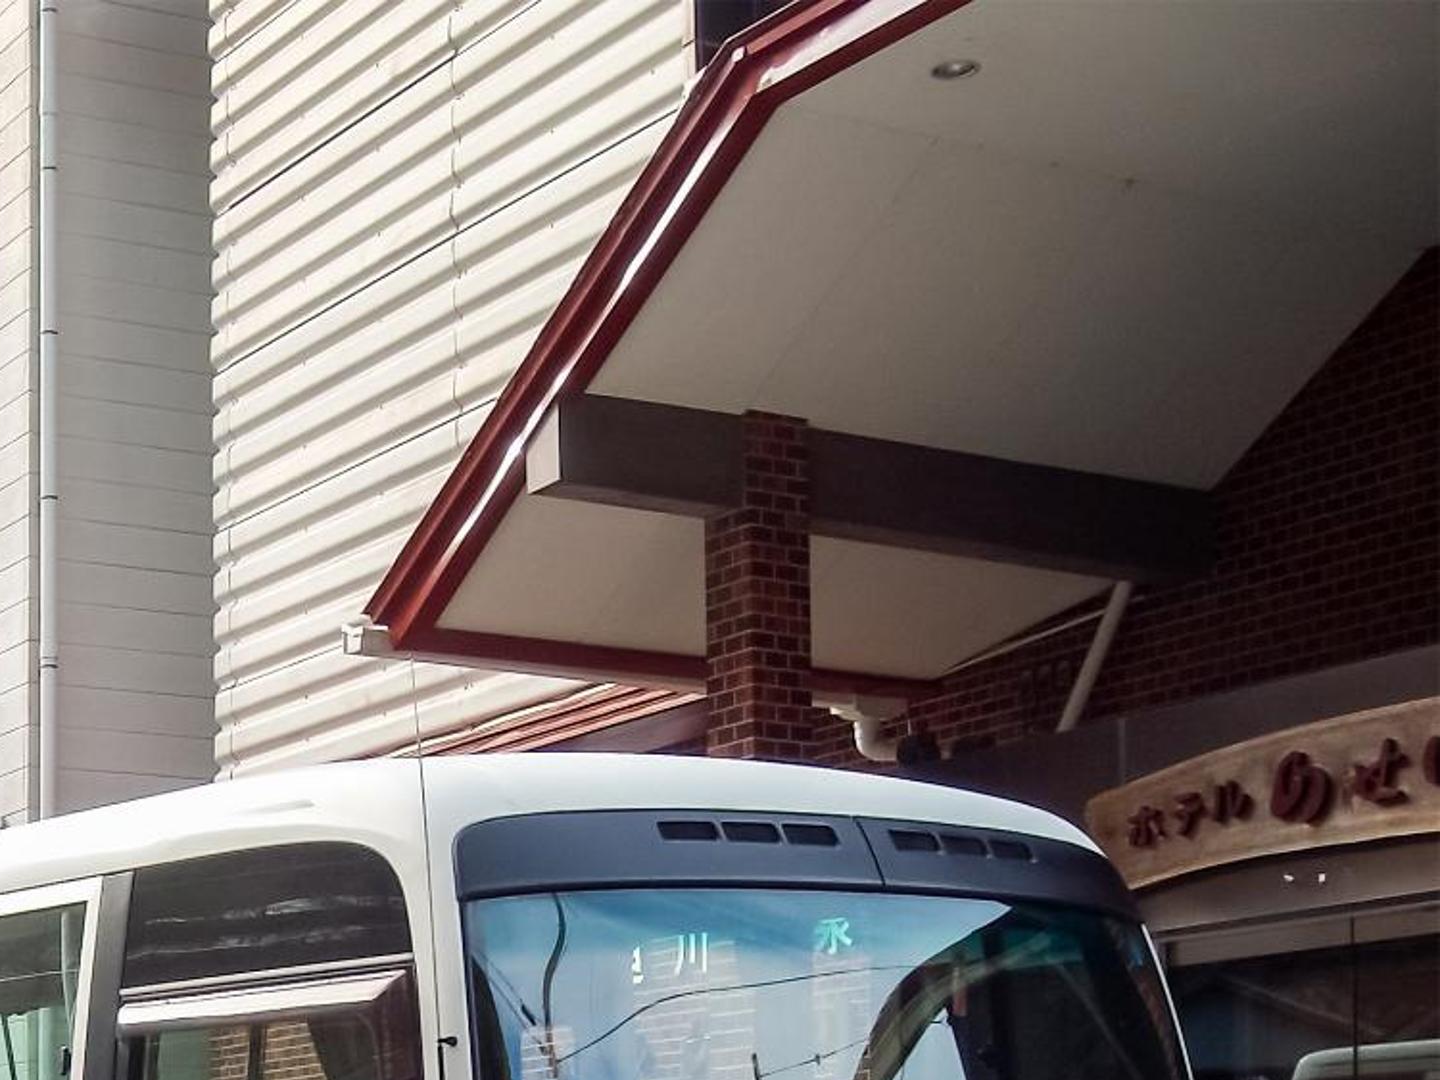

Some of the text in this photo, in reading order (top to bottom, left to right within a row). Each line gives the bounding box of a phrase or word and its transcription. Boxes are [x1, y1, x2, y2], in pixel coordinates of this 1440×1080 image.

[1126, 736, 1440, 849] ホテルのせ
